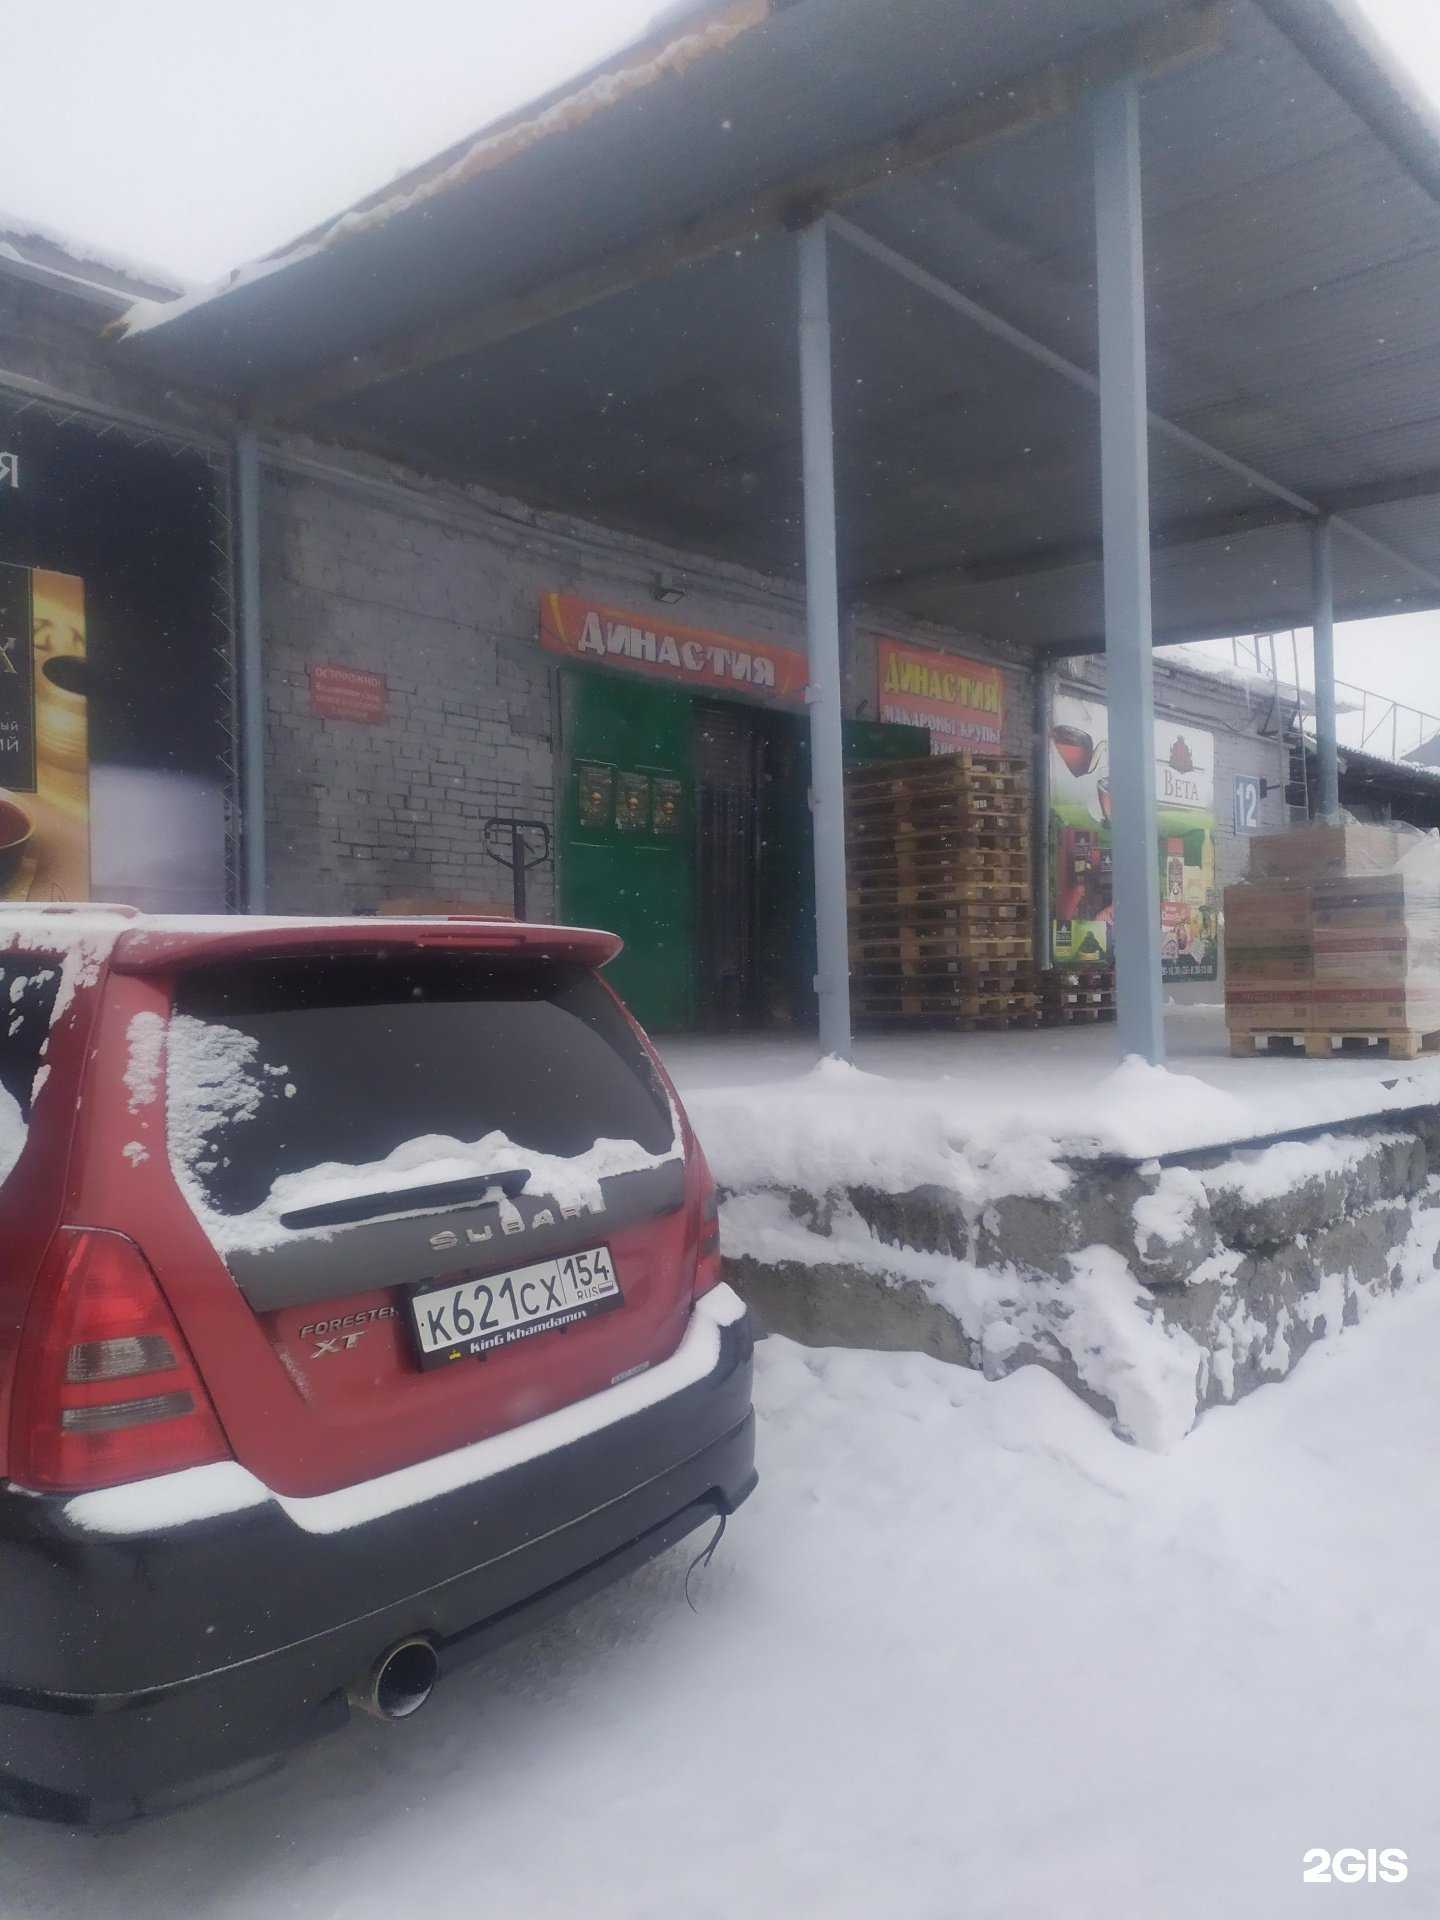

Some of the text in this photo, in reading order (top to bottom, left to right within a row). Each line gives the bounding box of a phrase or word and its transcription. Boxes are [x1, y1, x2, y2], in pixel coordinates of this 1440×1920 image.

[577, 611, 775, 687] ДИНАСТИЯ
[884, 651, 999, 714] ДИНАСТИЯ
[1236, 783, 1257, 827] 12
[563, 1251, 609, 1289] 154
[577, 1286, 599, 1300] RUS
[310, 1330, 366, 1359] XT
